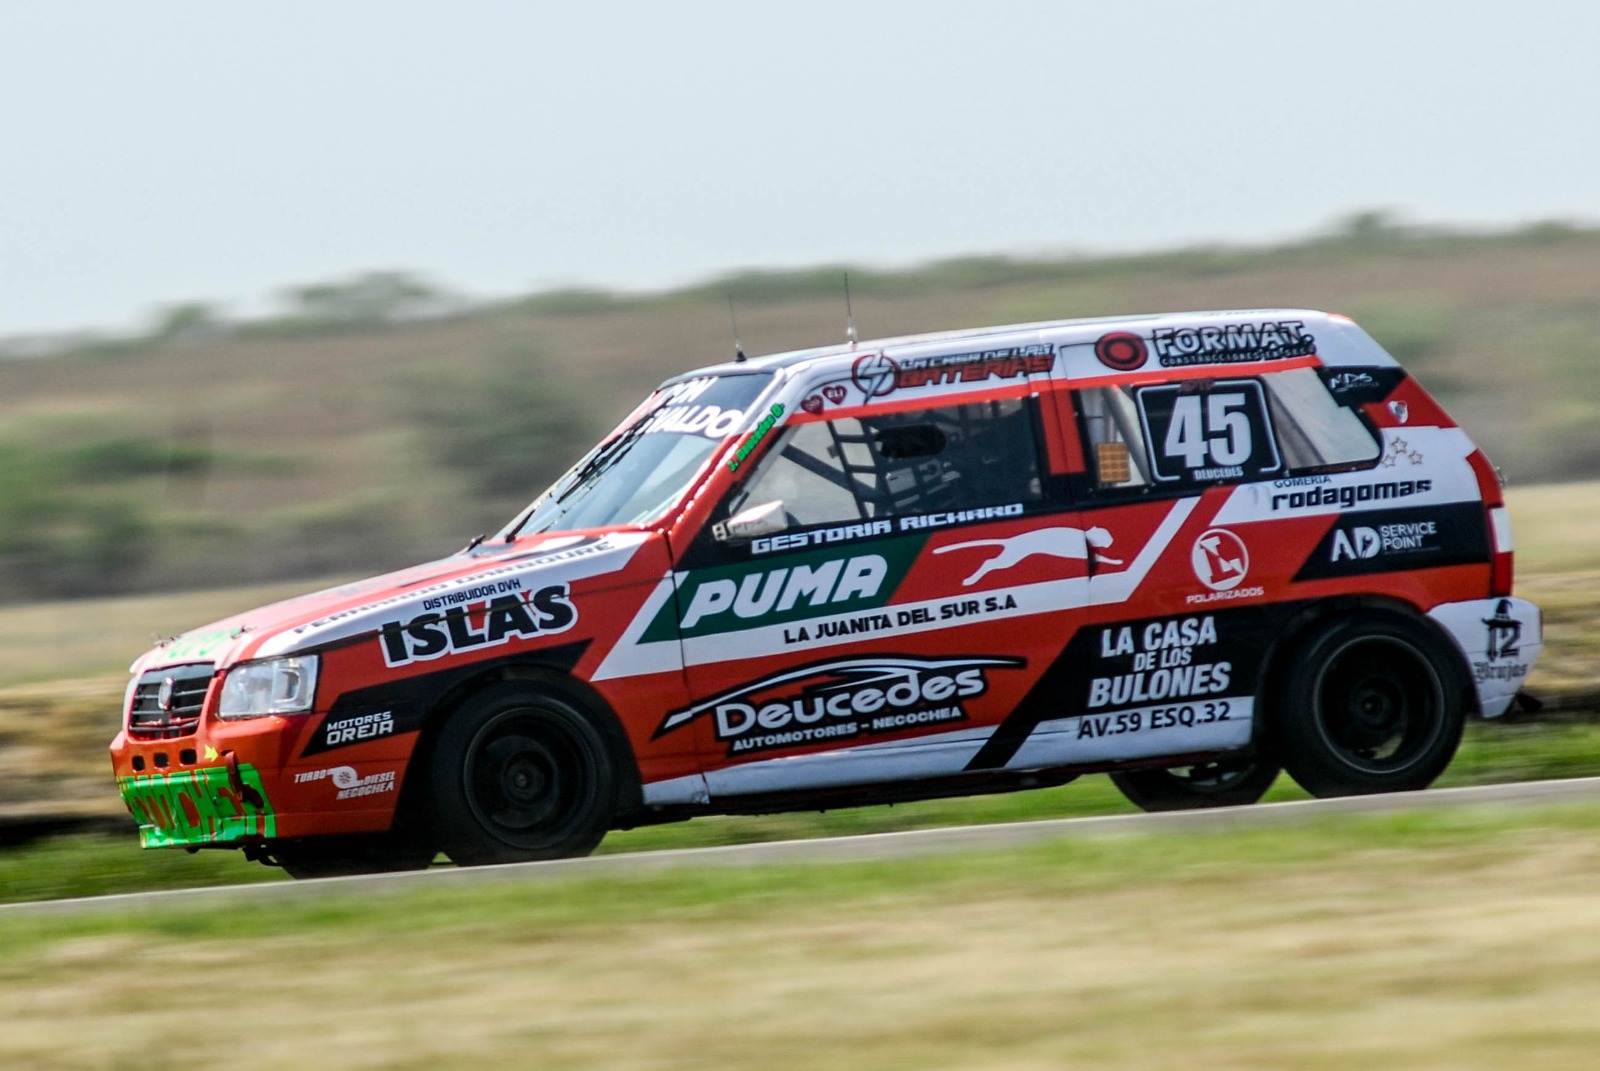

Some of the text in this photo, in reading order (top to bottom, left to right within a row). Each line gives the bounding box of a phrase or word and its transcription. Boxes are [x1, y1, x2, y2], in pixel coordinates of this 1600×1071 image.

[1164, 392, 1252, 468] 45
[1193, 465, 1244, 481] DEUCEDES
[1272, 478, 1432, 510] rodagomas
[751, 503, 1024, 555] GESTORIA RICHARD
[1381, 521, 1438, 538] SERVICE
[1382, 535, 1424, 551] POINT
[423, 578, 522, 612] DISTRIBUIDOR DVH
[679, 554, 888, 630] PUMA
[1186, 586, 1265, 605] POLARIZADOS
[380, 582, 576, 665] ISLAS
[783, 627, 810, 645] LA
[814, 614, 893, 641] JUANITA
[897, 607, 936, 628] DEL
[940, 600, 981, 620] SUR
[1102, 615, 1218, 658] LA CASA
[1133, 646, 1193, 673] DE LOS
[715, 668, 986, 738] Deucedes
[1087, 661, 1232, 708] BULONES
[326, 710, 392, 732] MOTORES
[326, 719, 395, 746] OREJA
[733, 722, 858, 752] AUTOMOTORES
[872, 706, 962, 730] NECOCHEA
[1076, 701, 1231, 741] AV.59 ESQ.32
[294, 768, 327, 784] TURBO
